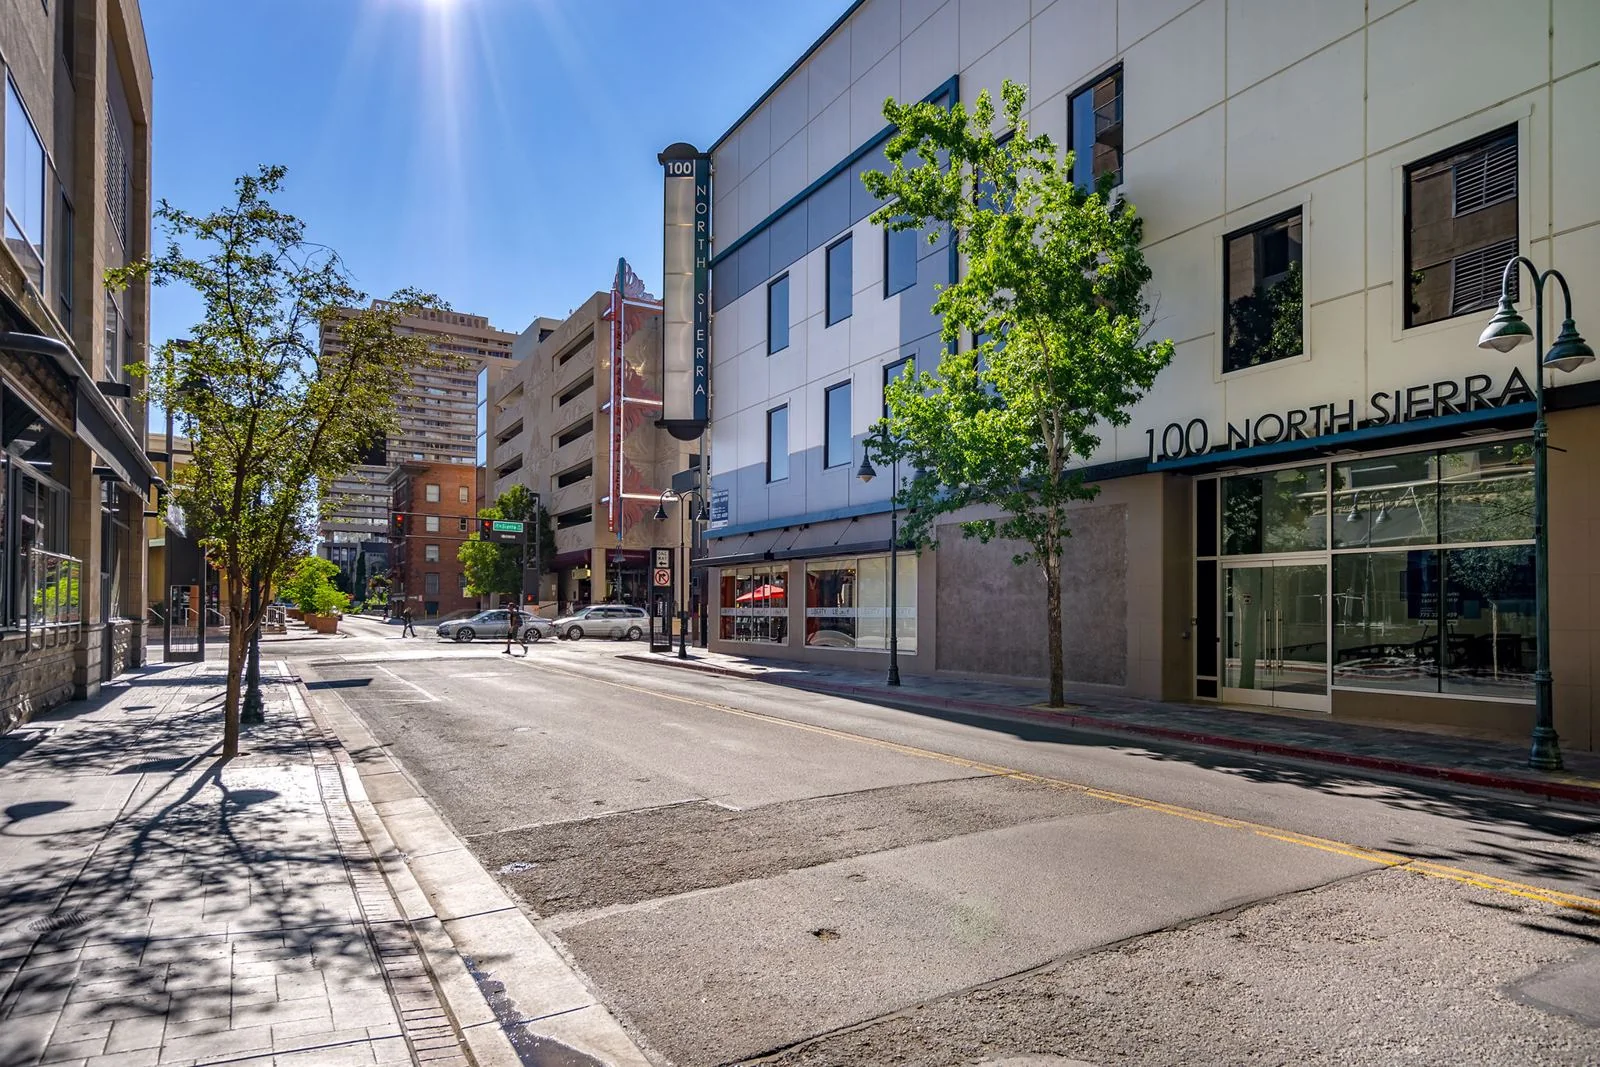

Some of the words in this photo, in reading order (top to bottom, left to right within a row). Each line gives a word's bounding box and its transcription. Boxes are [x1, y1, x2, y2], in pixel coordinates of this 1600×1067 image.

[668, 162, 692, 175] 100
[695, 184, 707, 268] NORTH
[695, 293, 706, 396] SIERRA
[1145, 418, 1211, 464] 100
[1227, 399, 1356, 451] NORTH
[1370, 366, 1537, 427] SIERRA
